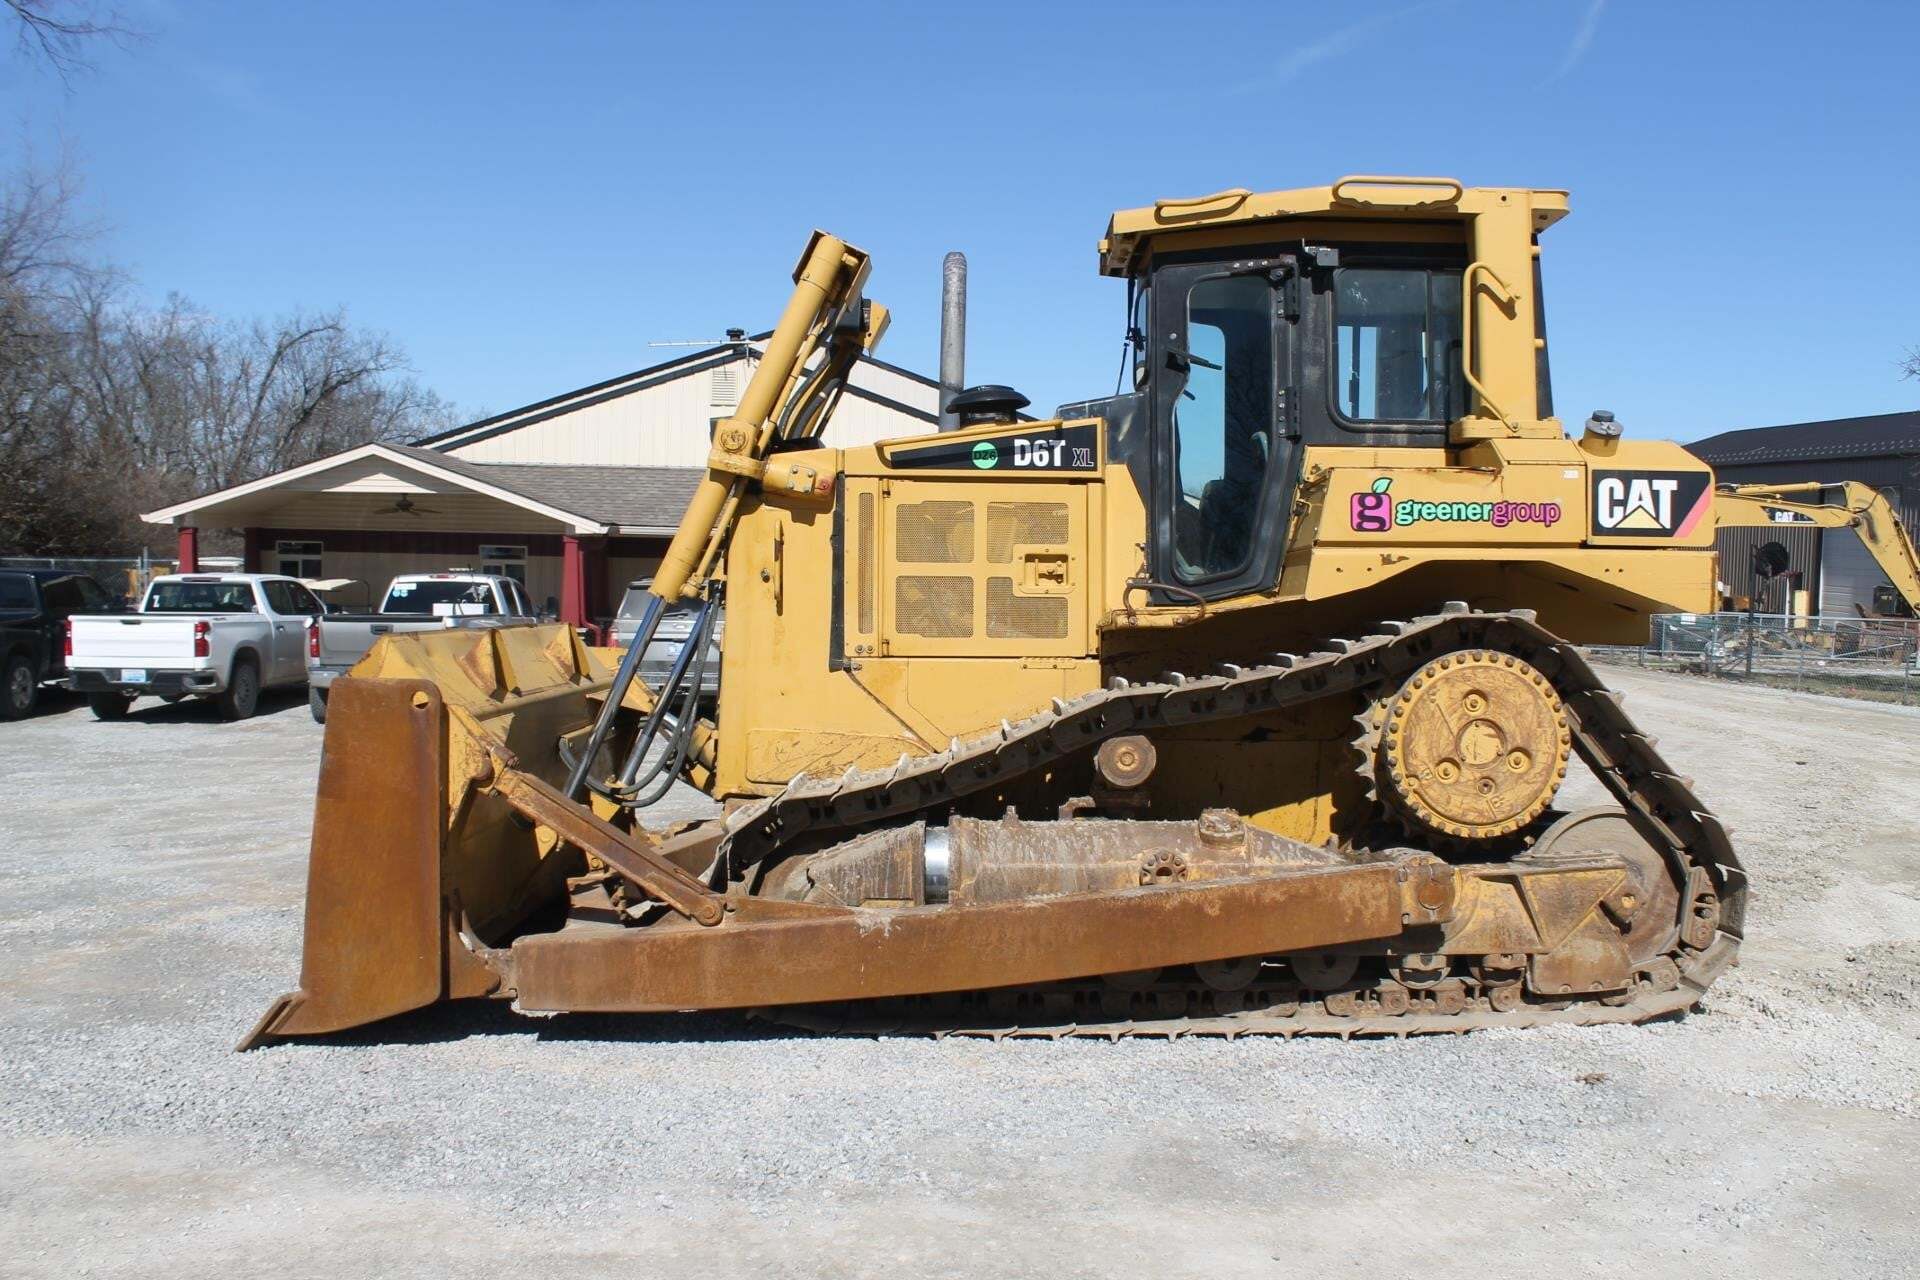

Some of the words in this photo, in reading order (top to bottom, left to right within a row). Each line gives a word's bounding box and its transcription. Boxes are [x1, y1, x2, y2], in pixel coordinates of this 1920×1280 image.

[1014, 439, 1066, 467] D6T
[1072, 448, 1094, 467] XL
[1395, 499, 1561, 527] greenergroup
[1597, 477, 1677, 529] CAT
[1775, 511, 1795, 522] CAT
